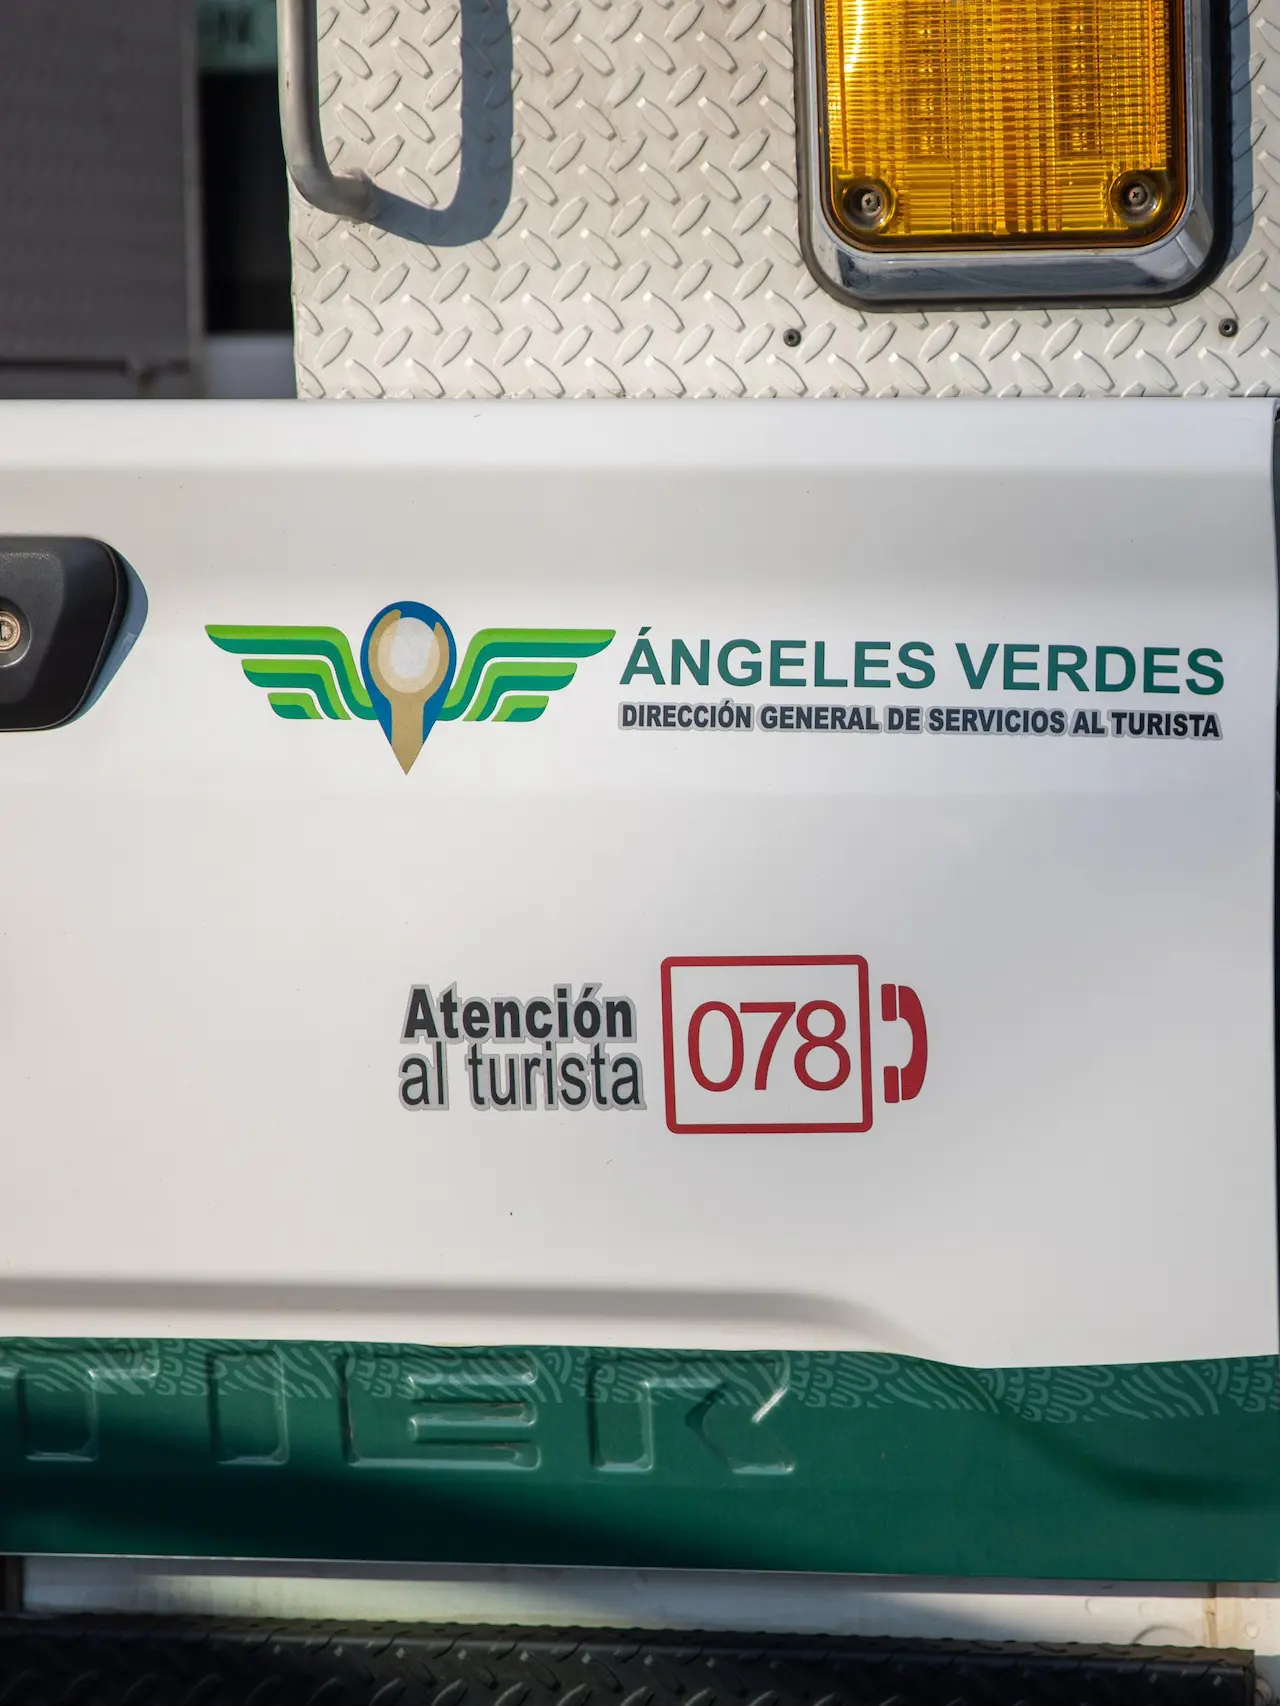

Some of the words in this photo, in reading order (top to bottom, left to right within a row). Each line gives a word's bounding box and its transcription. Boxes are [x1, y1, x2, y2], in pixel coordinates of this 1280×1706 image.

[619, 626, 936, 689] ÁNGELES
[955, 642, 1225, 696] VERDES
[620, 699, 752, 730] DIRECCIÓN
[760, 704, 880, 732] GENERAL
[888, 706, 921, 733] DE
[928, 707, 1065, 735] SERVICIOS
[1072, 710, 1106, 736] AL
[1111, 711, 1221, 738] TURISTA
[403, 982, 634, 1039] Atención
[401, 1041, 444, 1107] al
[467, 1041, 642, 1107] turista
[687, 1000, 852, 1093] 078
